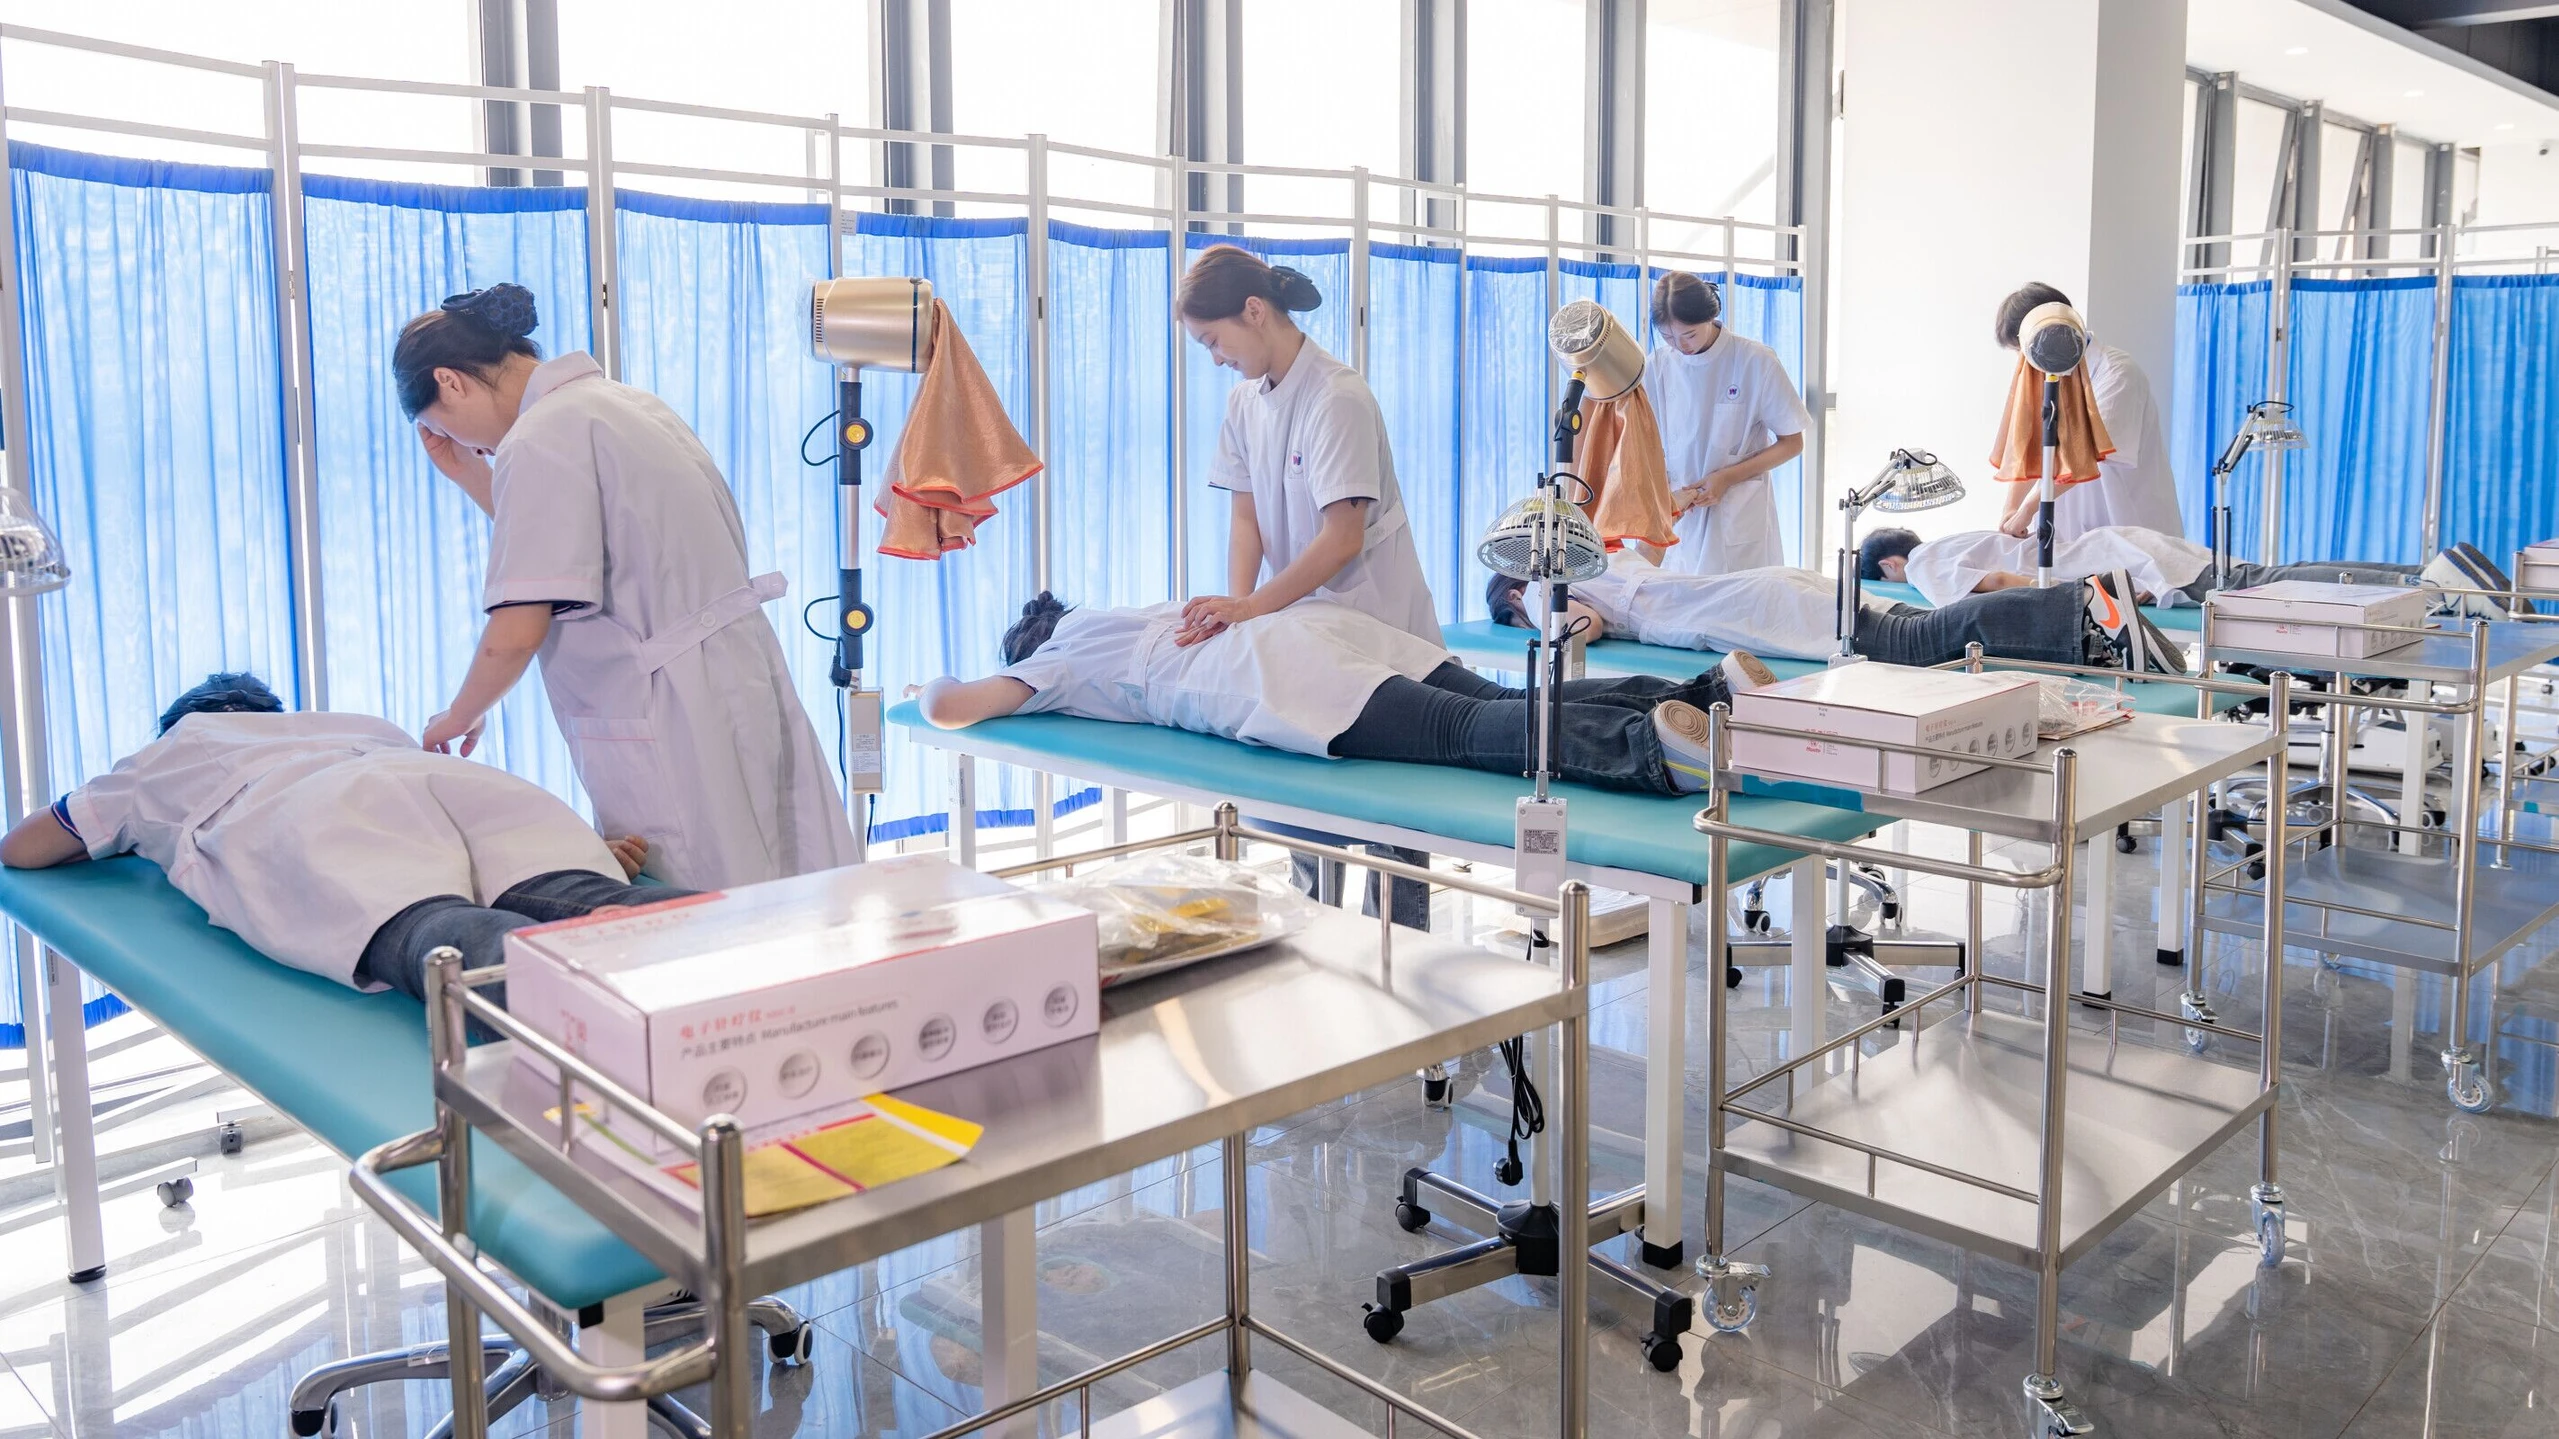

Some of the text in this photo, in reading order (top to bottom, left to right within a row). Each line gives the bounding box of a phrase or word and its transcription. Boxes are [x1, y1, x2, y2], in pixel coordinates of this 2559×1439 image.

[761, 1016, 828, 1040] Manufacture
[829, 1008, 857, 1023] main
[857, 1000, 899, 1018] features
